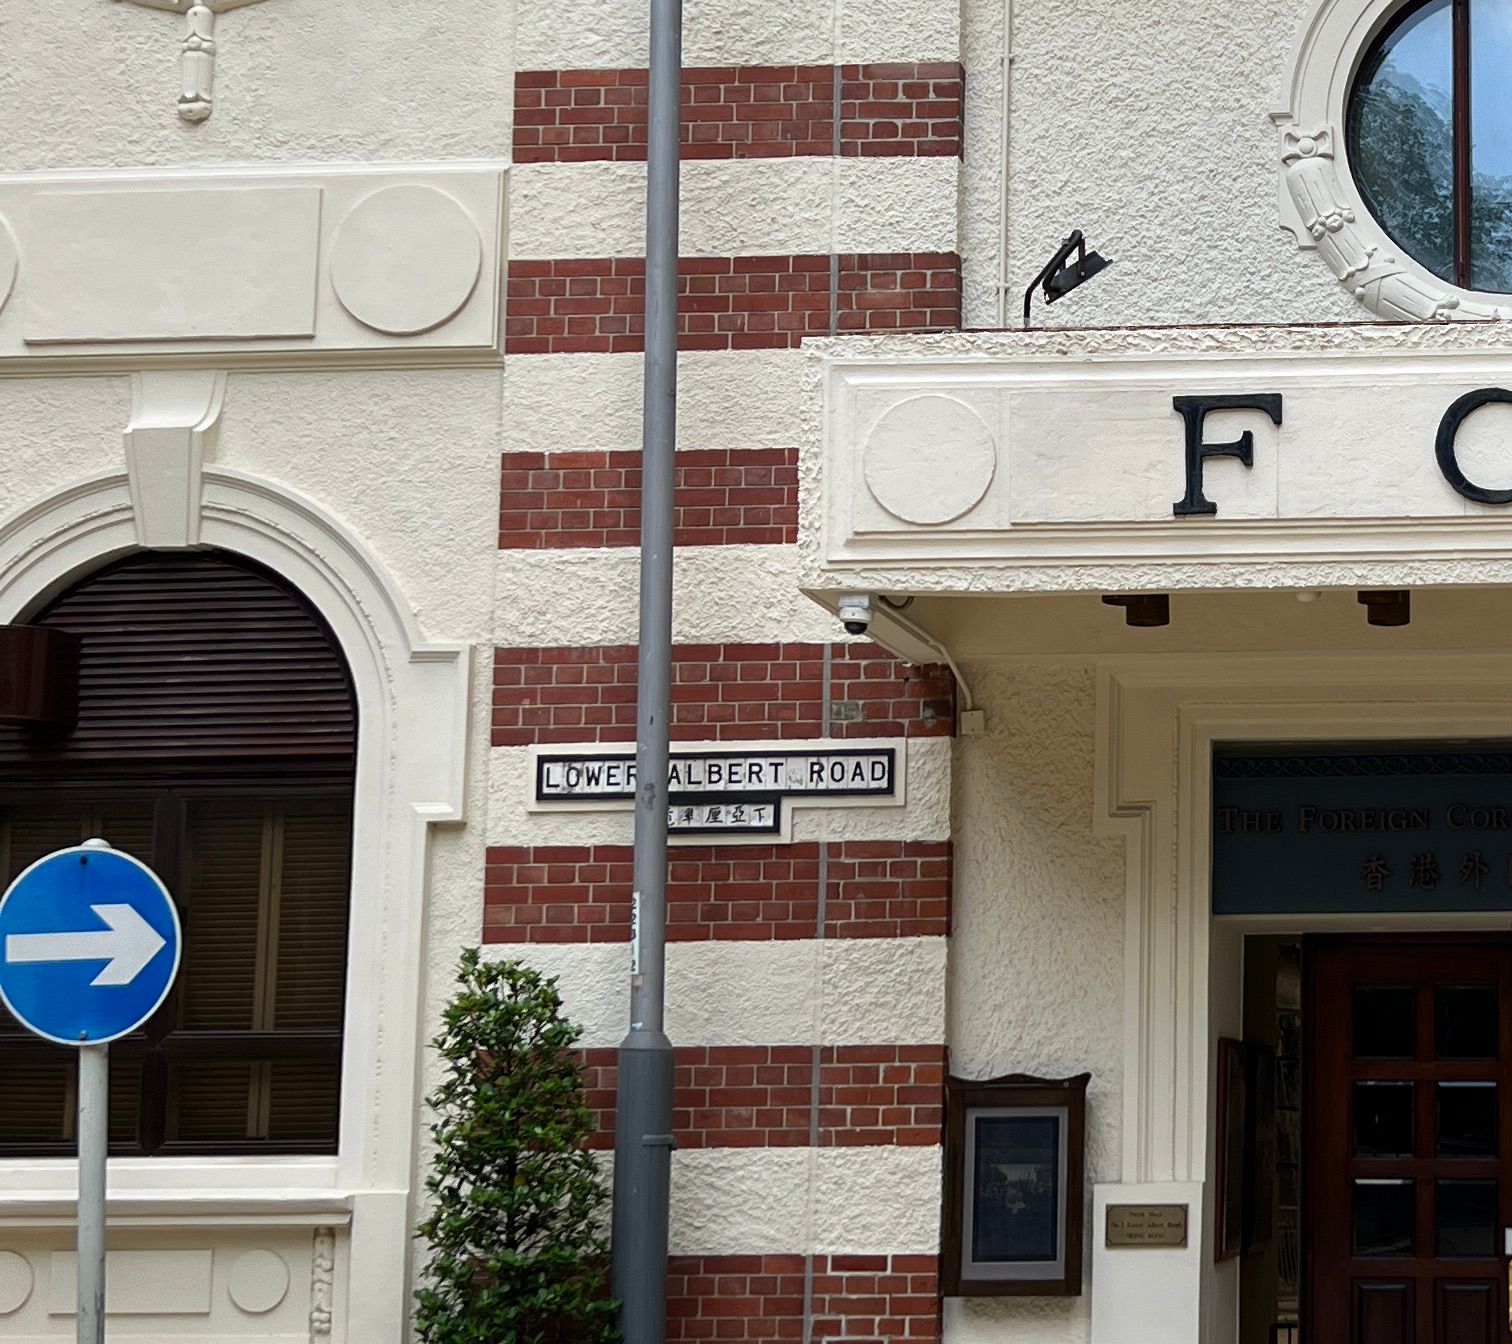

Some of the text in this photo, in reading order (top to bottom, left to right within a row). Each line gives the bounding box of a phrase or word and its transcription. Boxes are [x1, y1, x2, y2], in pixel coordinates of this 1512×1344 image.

[667, 761, 784, 785] ALBERT
[808, 759, 887, 783] ROAD
[1218, 807, 1282, 833] THE
[1297, 805, 1430, 832] FOREIGN
